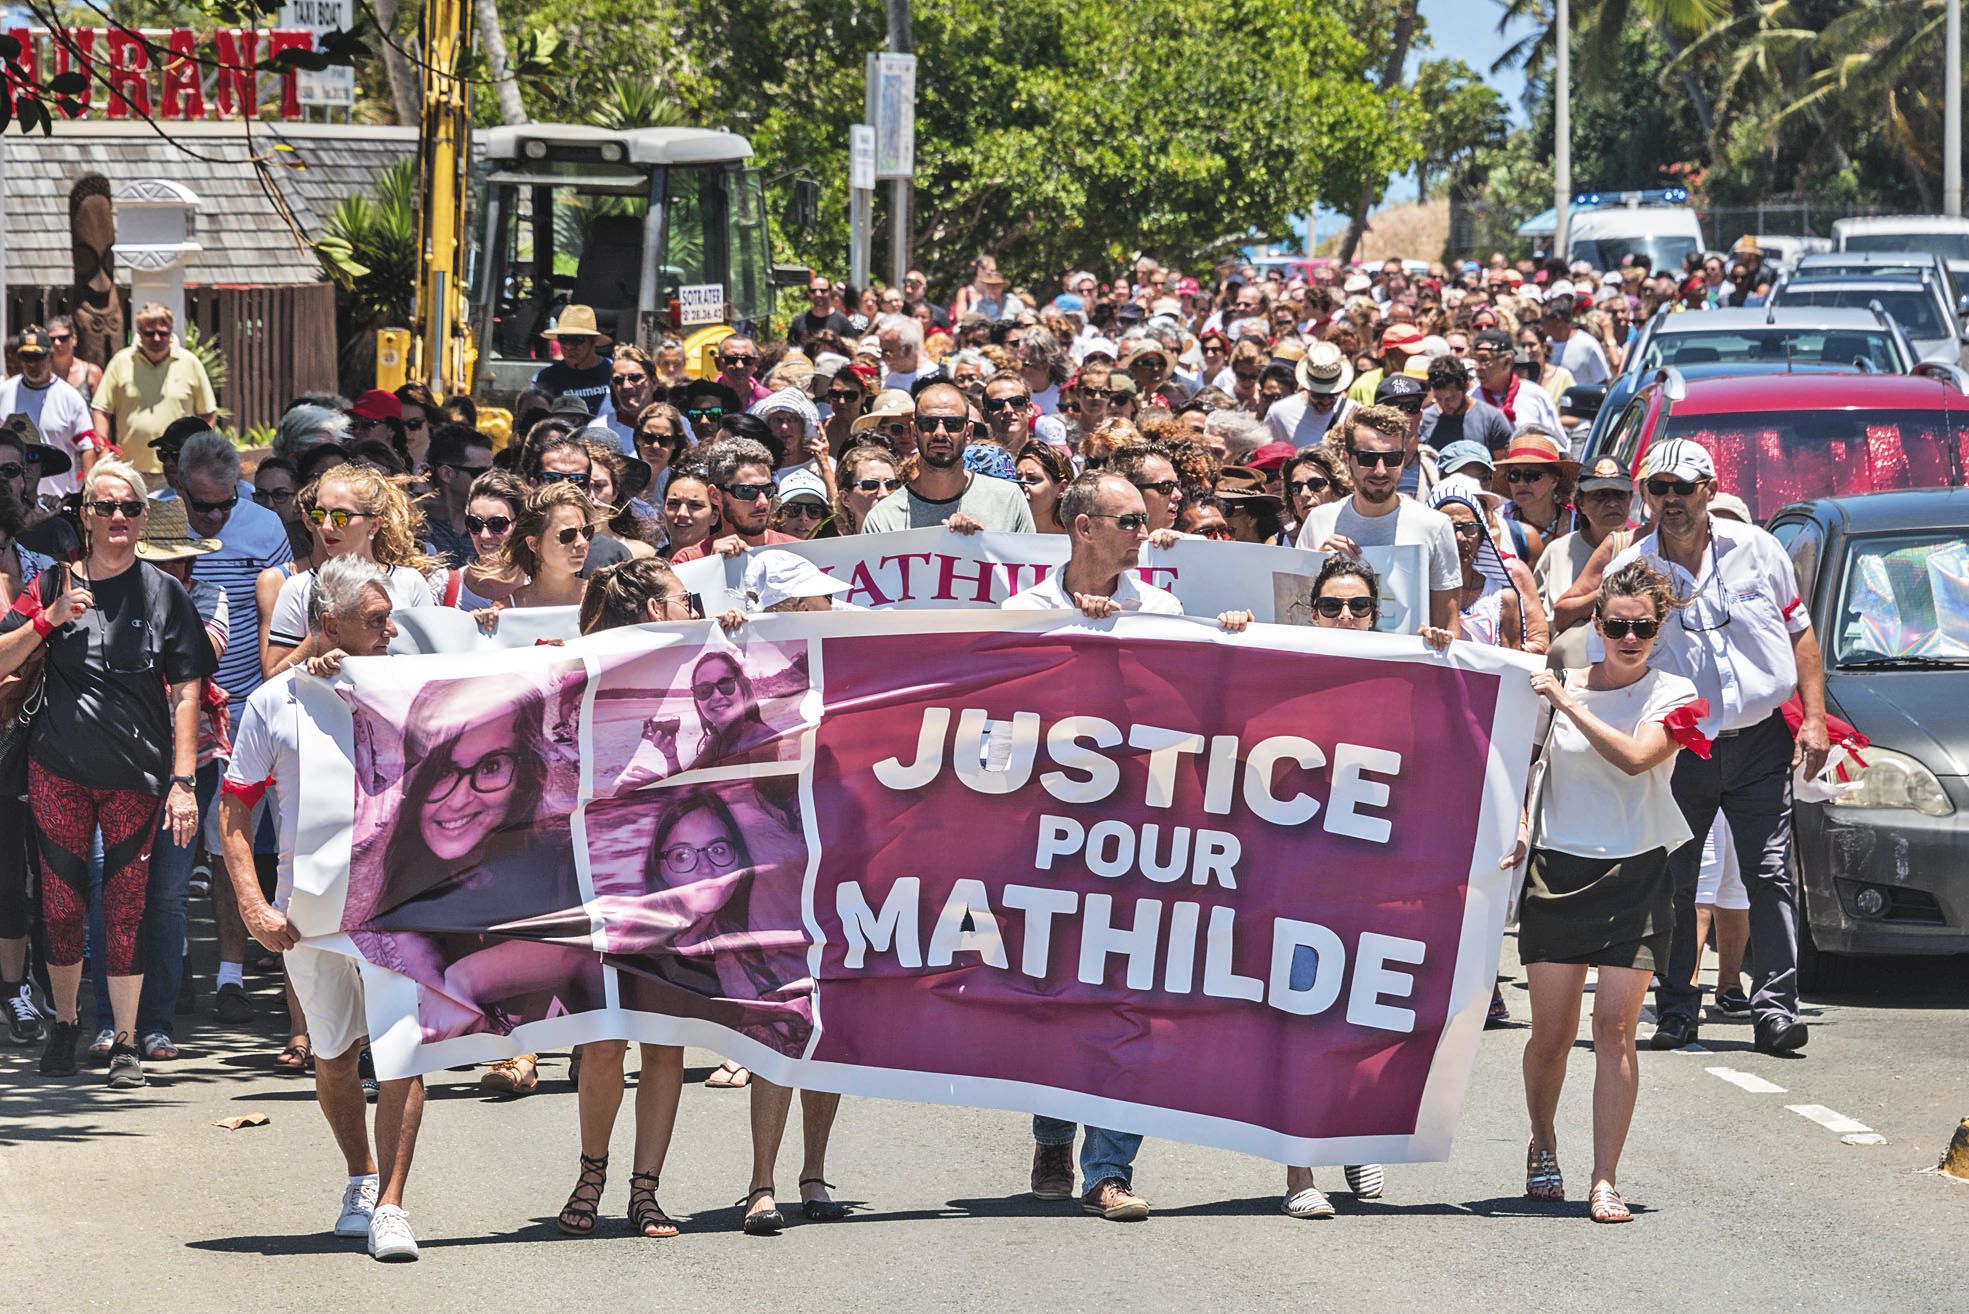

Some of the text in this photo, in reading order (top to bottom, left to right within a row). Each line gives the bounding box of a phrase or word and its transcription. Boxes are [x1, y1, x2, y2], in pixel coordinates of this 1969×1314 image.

[293, 0, 342, 25] TAXI BOAT
[682, 288, 721, 305] SOTRATER
[872, 707, 1401, 844] JUSTICE
[1034, 814, 1242, 890] POUR
[836, 876, 1426, 1033] MATHILDE
